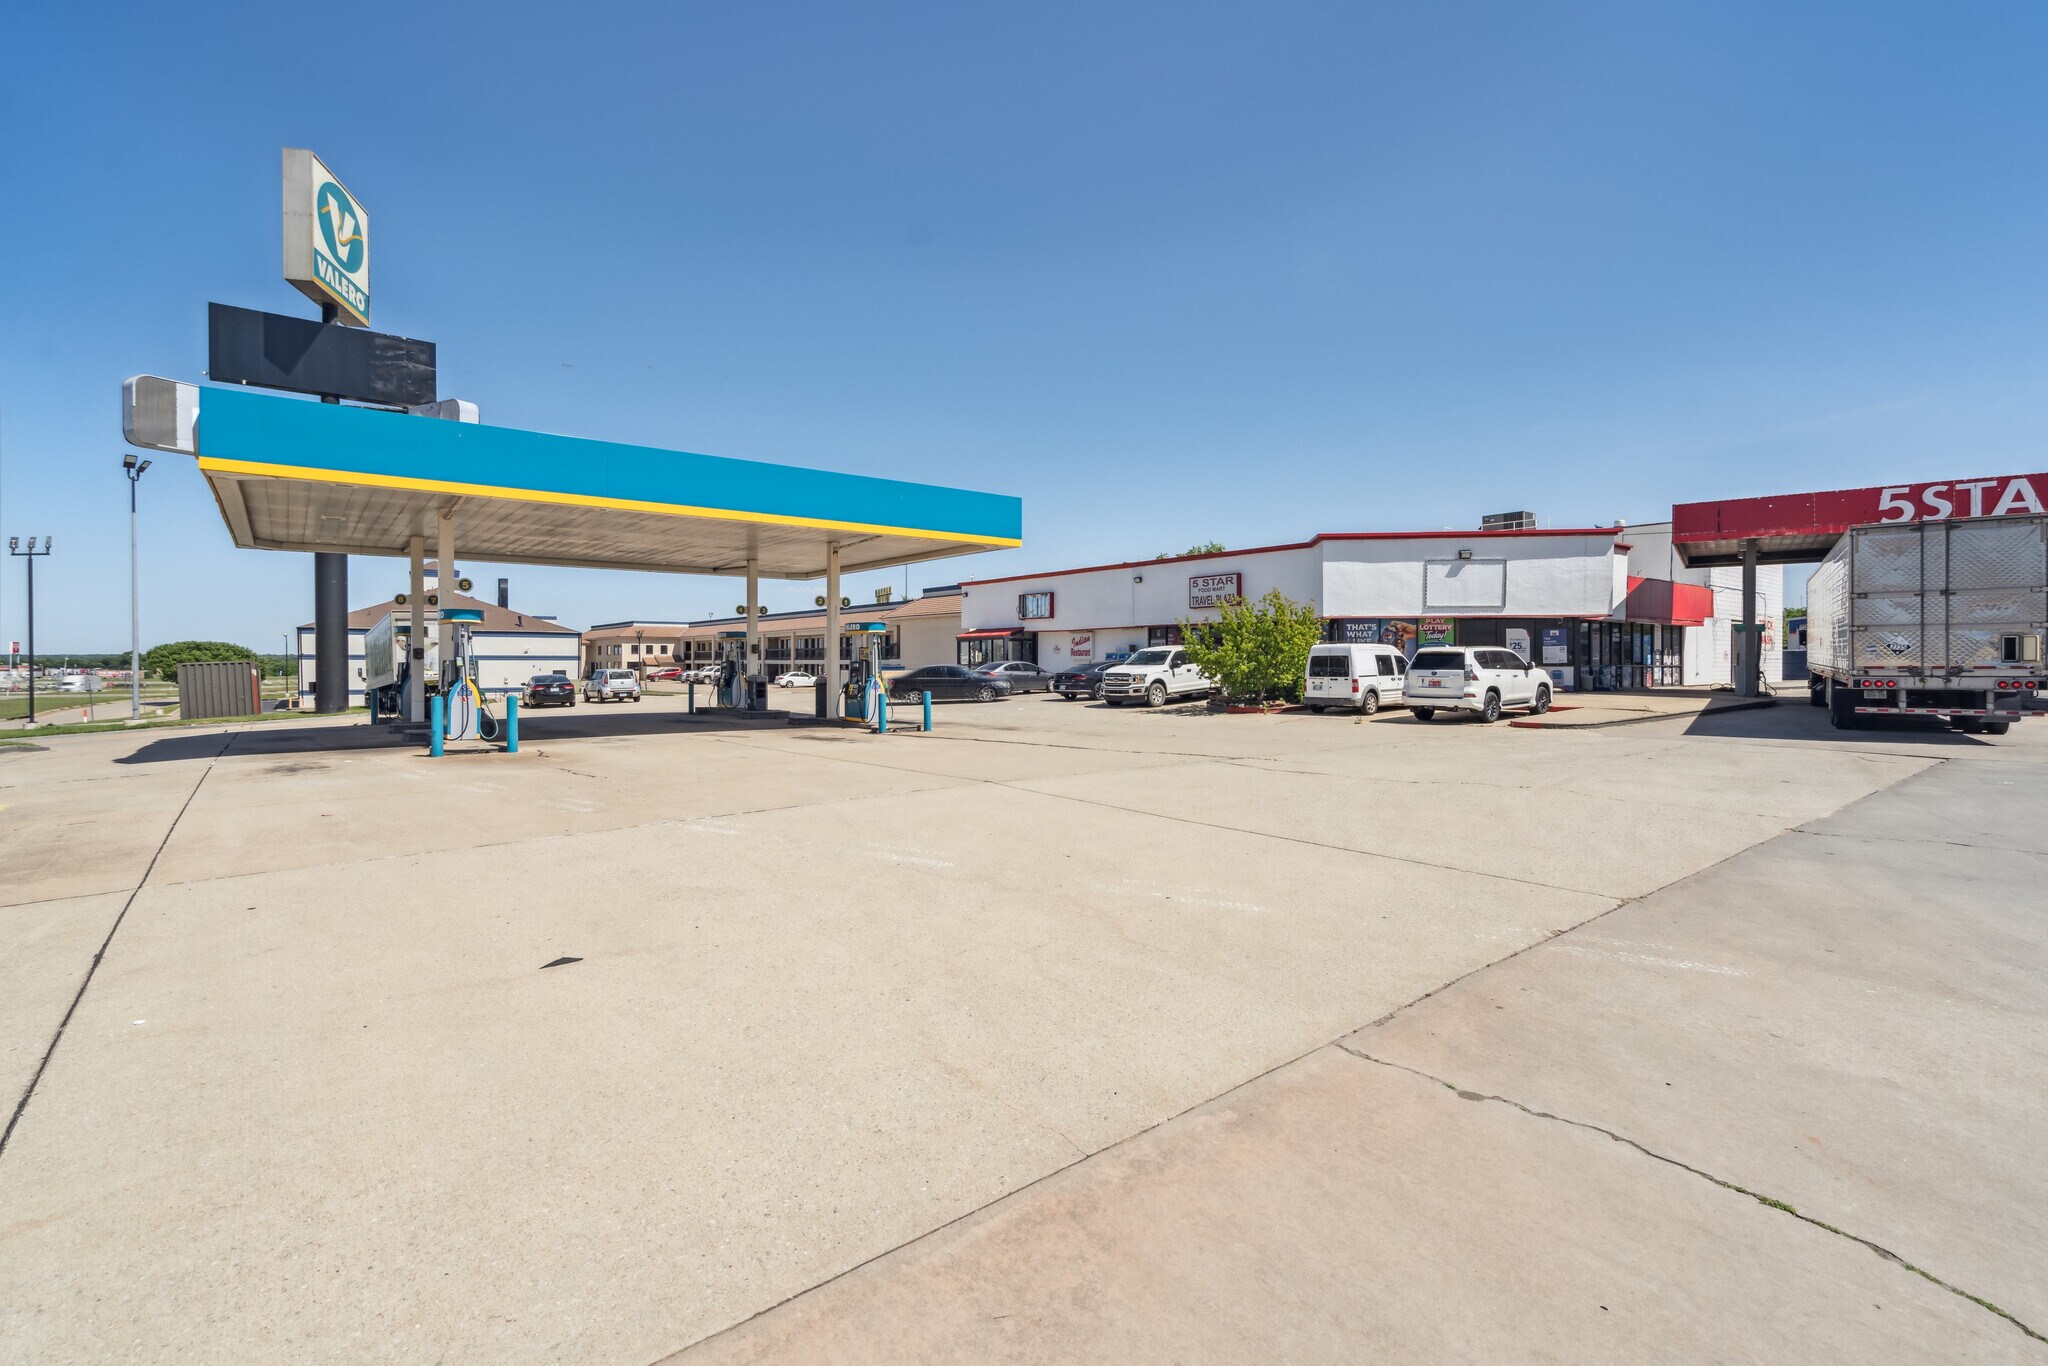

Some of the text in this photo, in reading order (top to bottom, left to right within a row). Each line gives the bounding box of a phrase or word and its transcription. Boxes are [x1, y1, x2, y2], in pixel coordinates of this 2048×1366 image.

[317, 254, 365, 313] VALERO
[461, 581, 469, 589] 5
[1192, 576, 1234, 588] 5 STAR
[1192, 595, 1214, 606] TRAVEL
[1346, 623, 1377, 631] THAT'S
[1346, 630, 1373, 638] WHAT
[1426, 630, 1448, 641] Today!
[1071, 635, 1091, 647] Indian
[1509, 641, 1523, 650] $25
[1070, 647, 1091, 657] Restaurant
